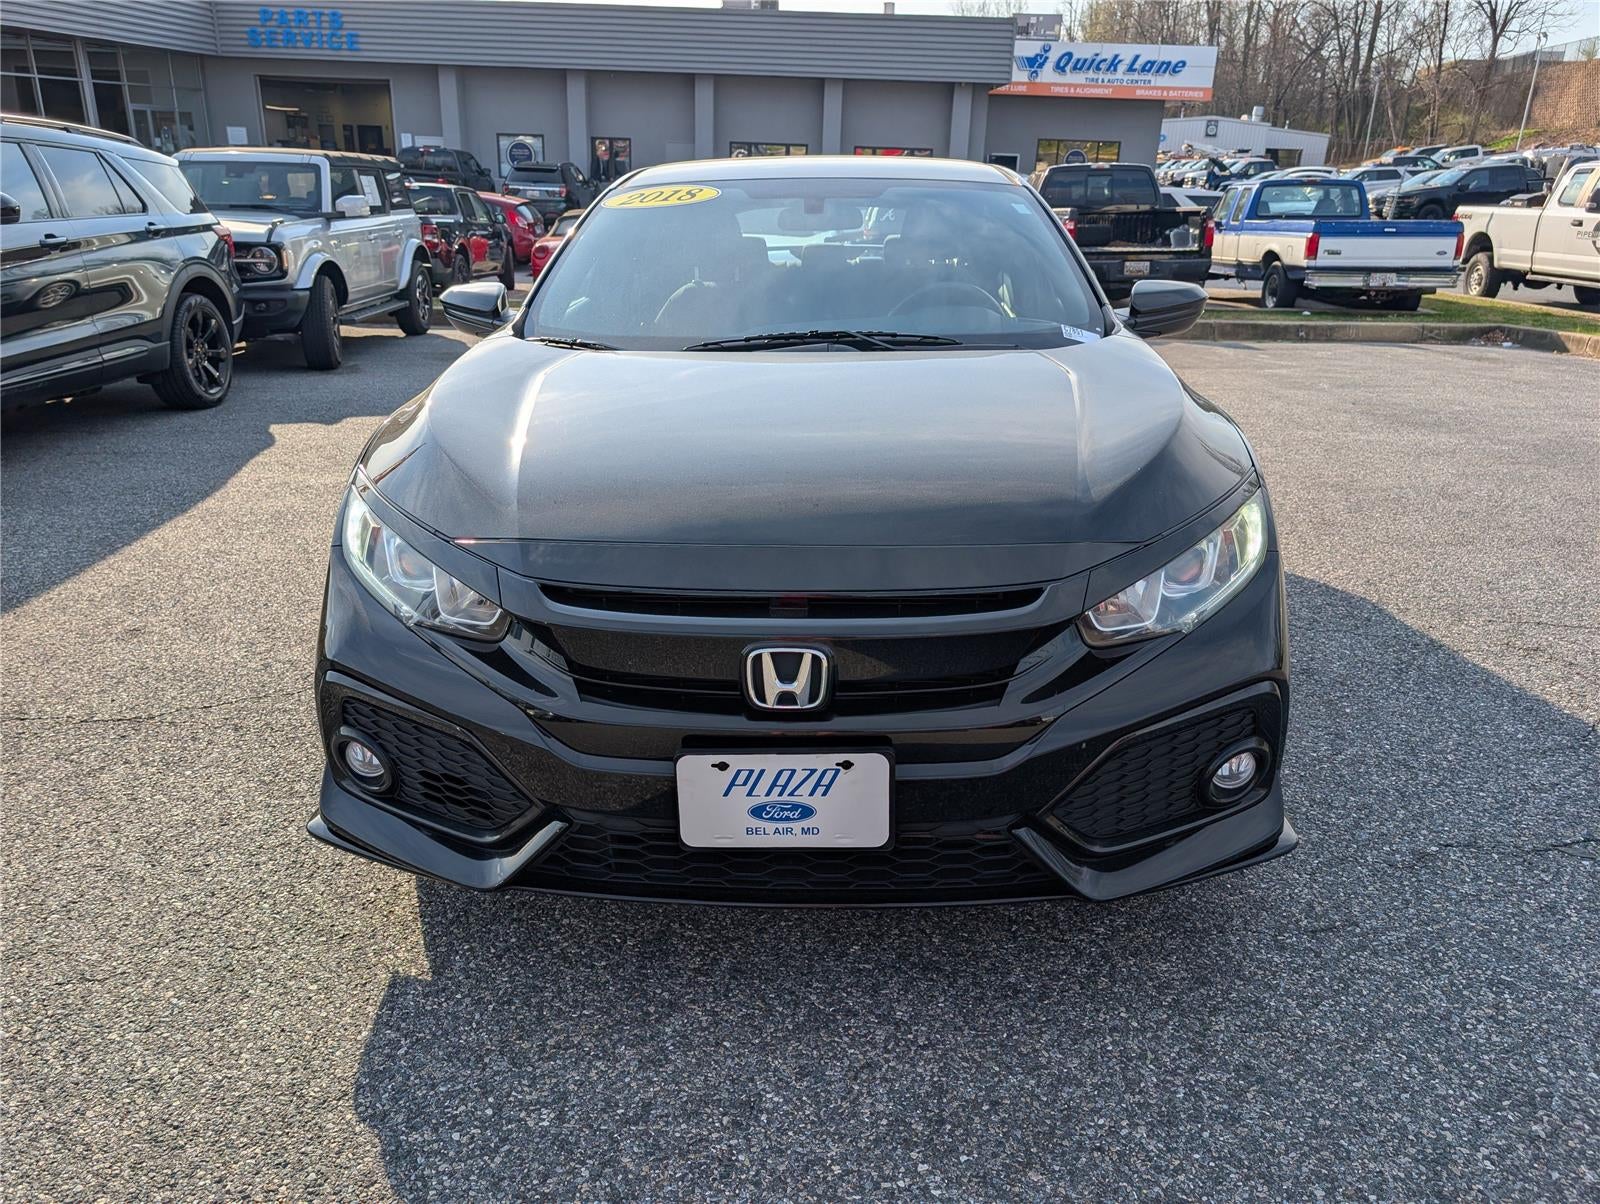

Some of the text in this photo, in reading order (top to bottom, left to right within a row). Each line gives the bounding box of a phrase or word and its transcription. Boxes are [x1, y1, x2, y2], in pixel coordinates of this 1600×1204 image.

[259, 7, 343, 29] PARTS
[247, 27, 360, 50] SERVICE
[1053, 51, 1187, 76] Quick Lane
[1075, 87, 1113, 95] ALIGNMENT
[1136, 89, 1161, 97] BRAKES
[1168, 90, 1204, 98] BATTERIES
[618, 188, 704, 206] 2018
[722, 768, 842, 798] PLAZA
[761, 803, 802, 820] Ford
[745, 826, 820, 837] BEL AIR, MD
